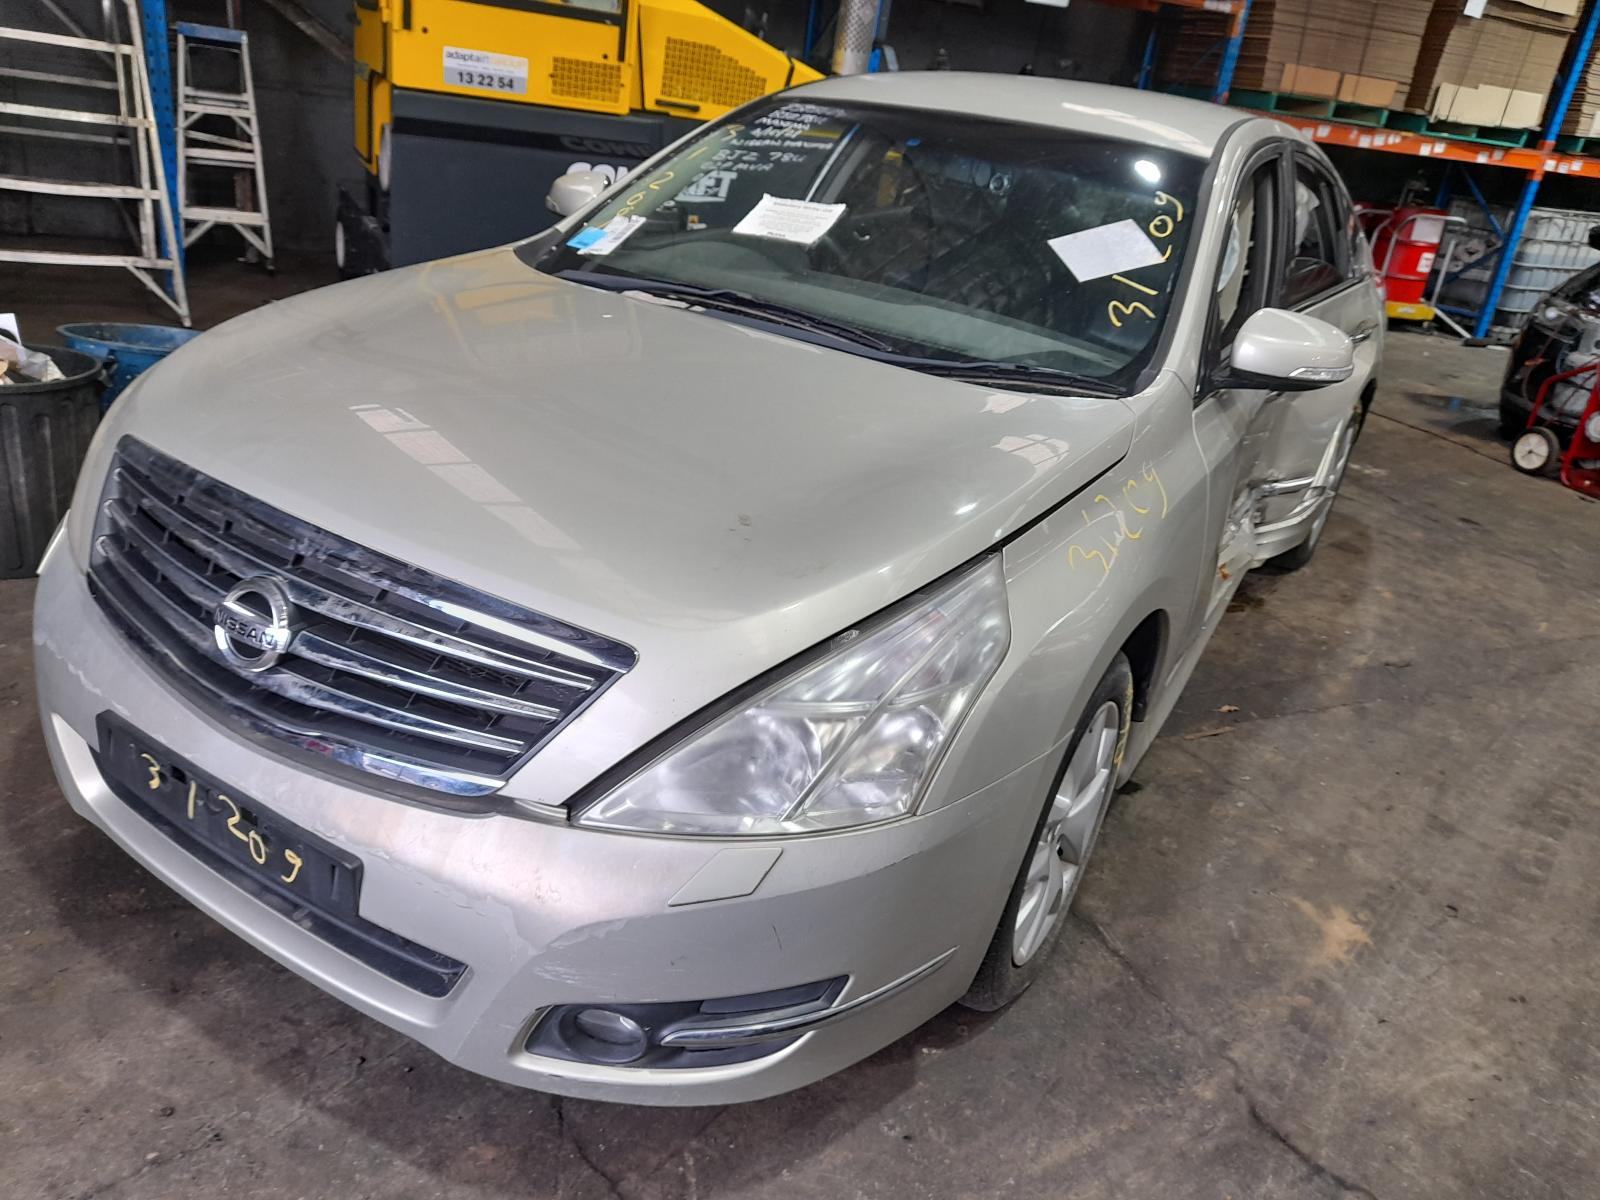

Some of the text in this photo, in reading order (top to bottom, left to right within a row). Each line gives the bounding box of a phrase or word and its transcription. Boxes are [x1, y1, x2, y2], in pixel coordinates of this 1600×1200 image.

[457, 71, 514, 89] 13 22 54
[215, 606, 276, 648] NISSAN
